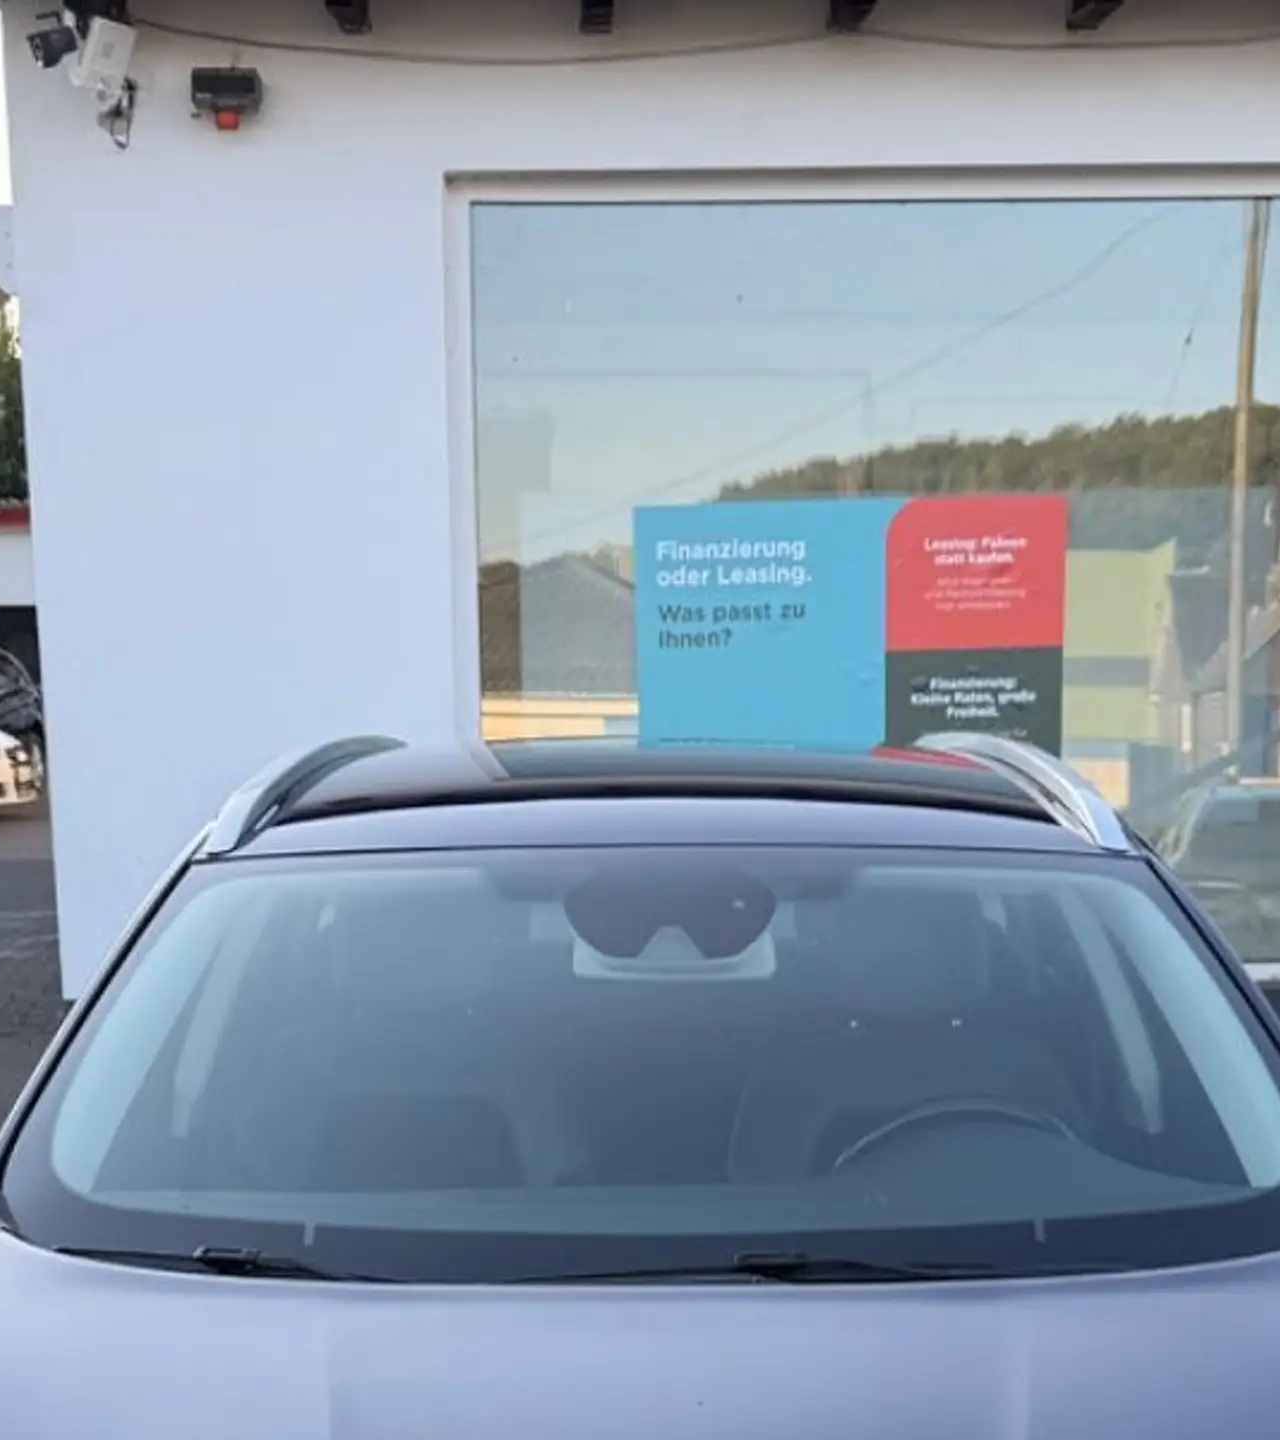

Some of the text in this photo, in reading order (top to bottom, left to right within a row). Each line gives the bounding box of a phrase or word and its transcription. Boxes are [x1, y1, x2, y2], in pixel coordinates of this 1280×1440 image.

[656, 538, 807, 562] Finanzierung
[656, 561, 813, 587] oder Leasing.
[657, 602, 807, 626] Was passt zu
[658, 628, 734, 650] Ihnen?
